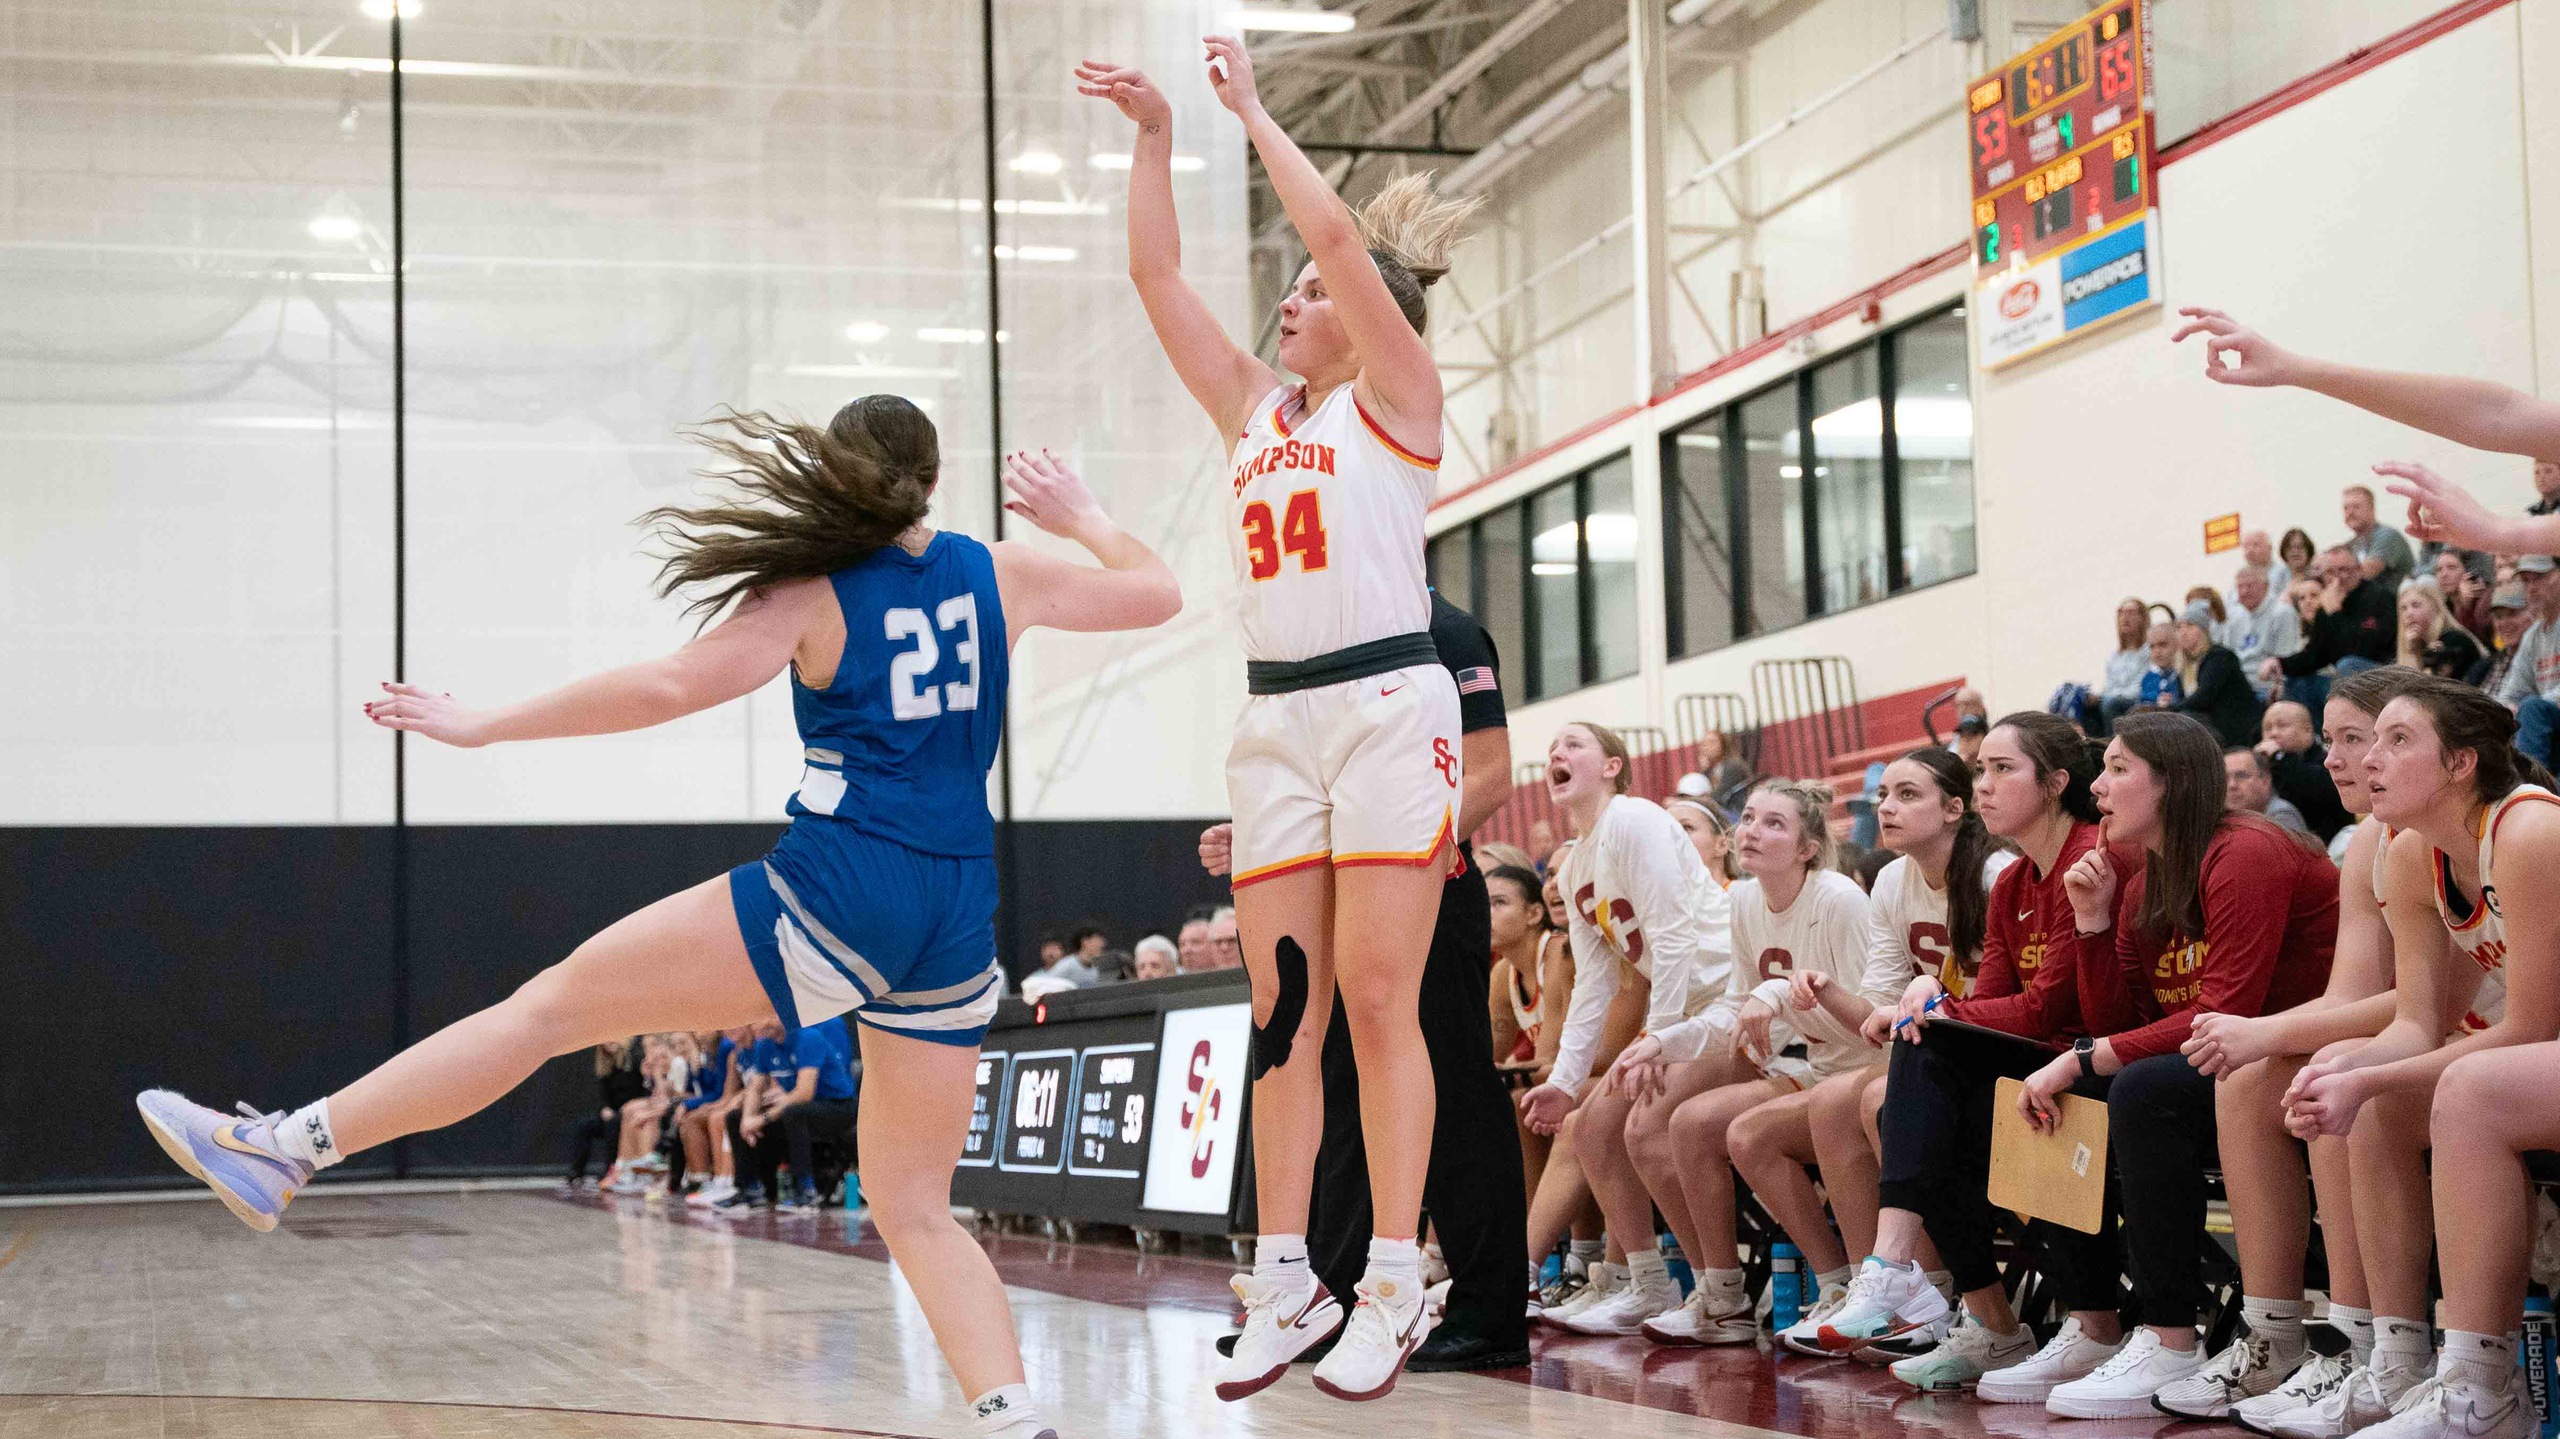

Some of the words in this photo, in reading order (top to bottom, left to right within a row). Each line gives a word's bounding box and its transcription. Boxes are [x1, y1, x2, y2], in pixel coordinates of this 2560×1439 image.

[2101, 39, 2134, 100] 65
[1976, 108, 2006, 165] 53
[2058, 111, 2074, 148] 4
[1986, 222, 1999, 263] 2
[1234, 440, 1336, 499] SIMPSON
[1241, 488, 1329, 582] 34
[884, 592, 980, 721] 23
[1433, 737, 1458, 789] SC
[1122, 1094, 1145, 1144] 53
